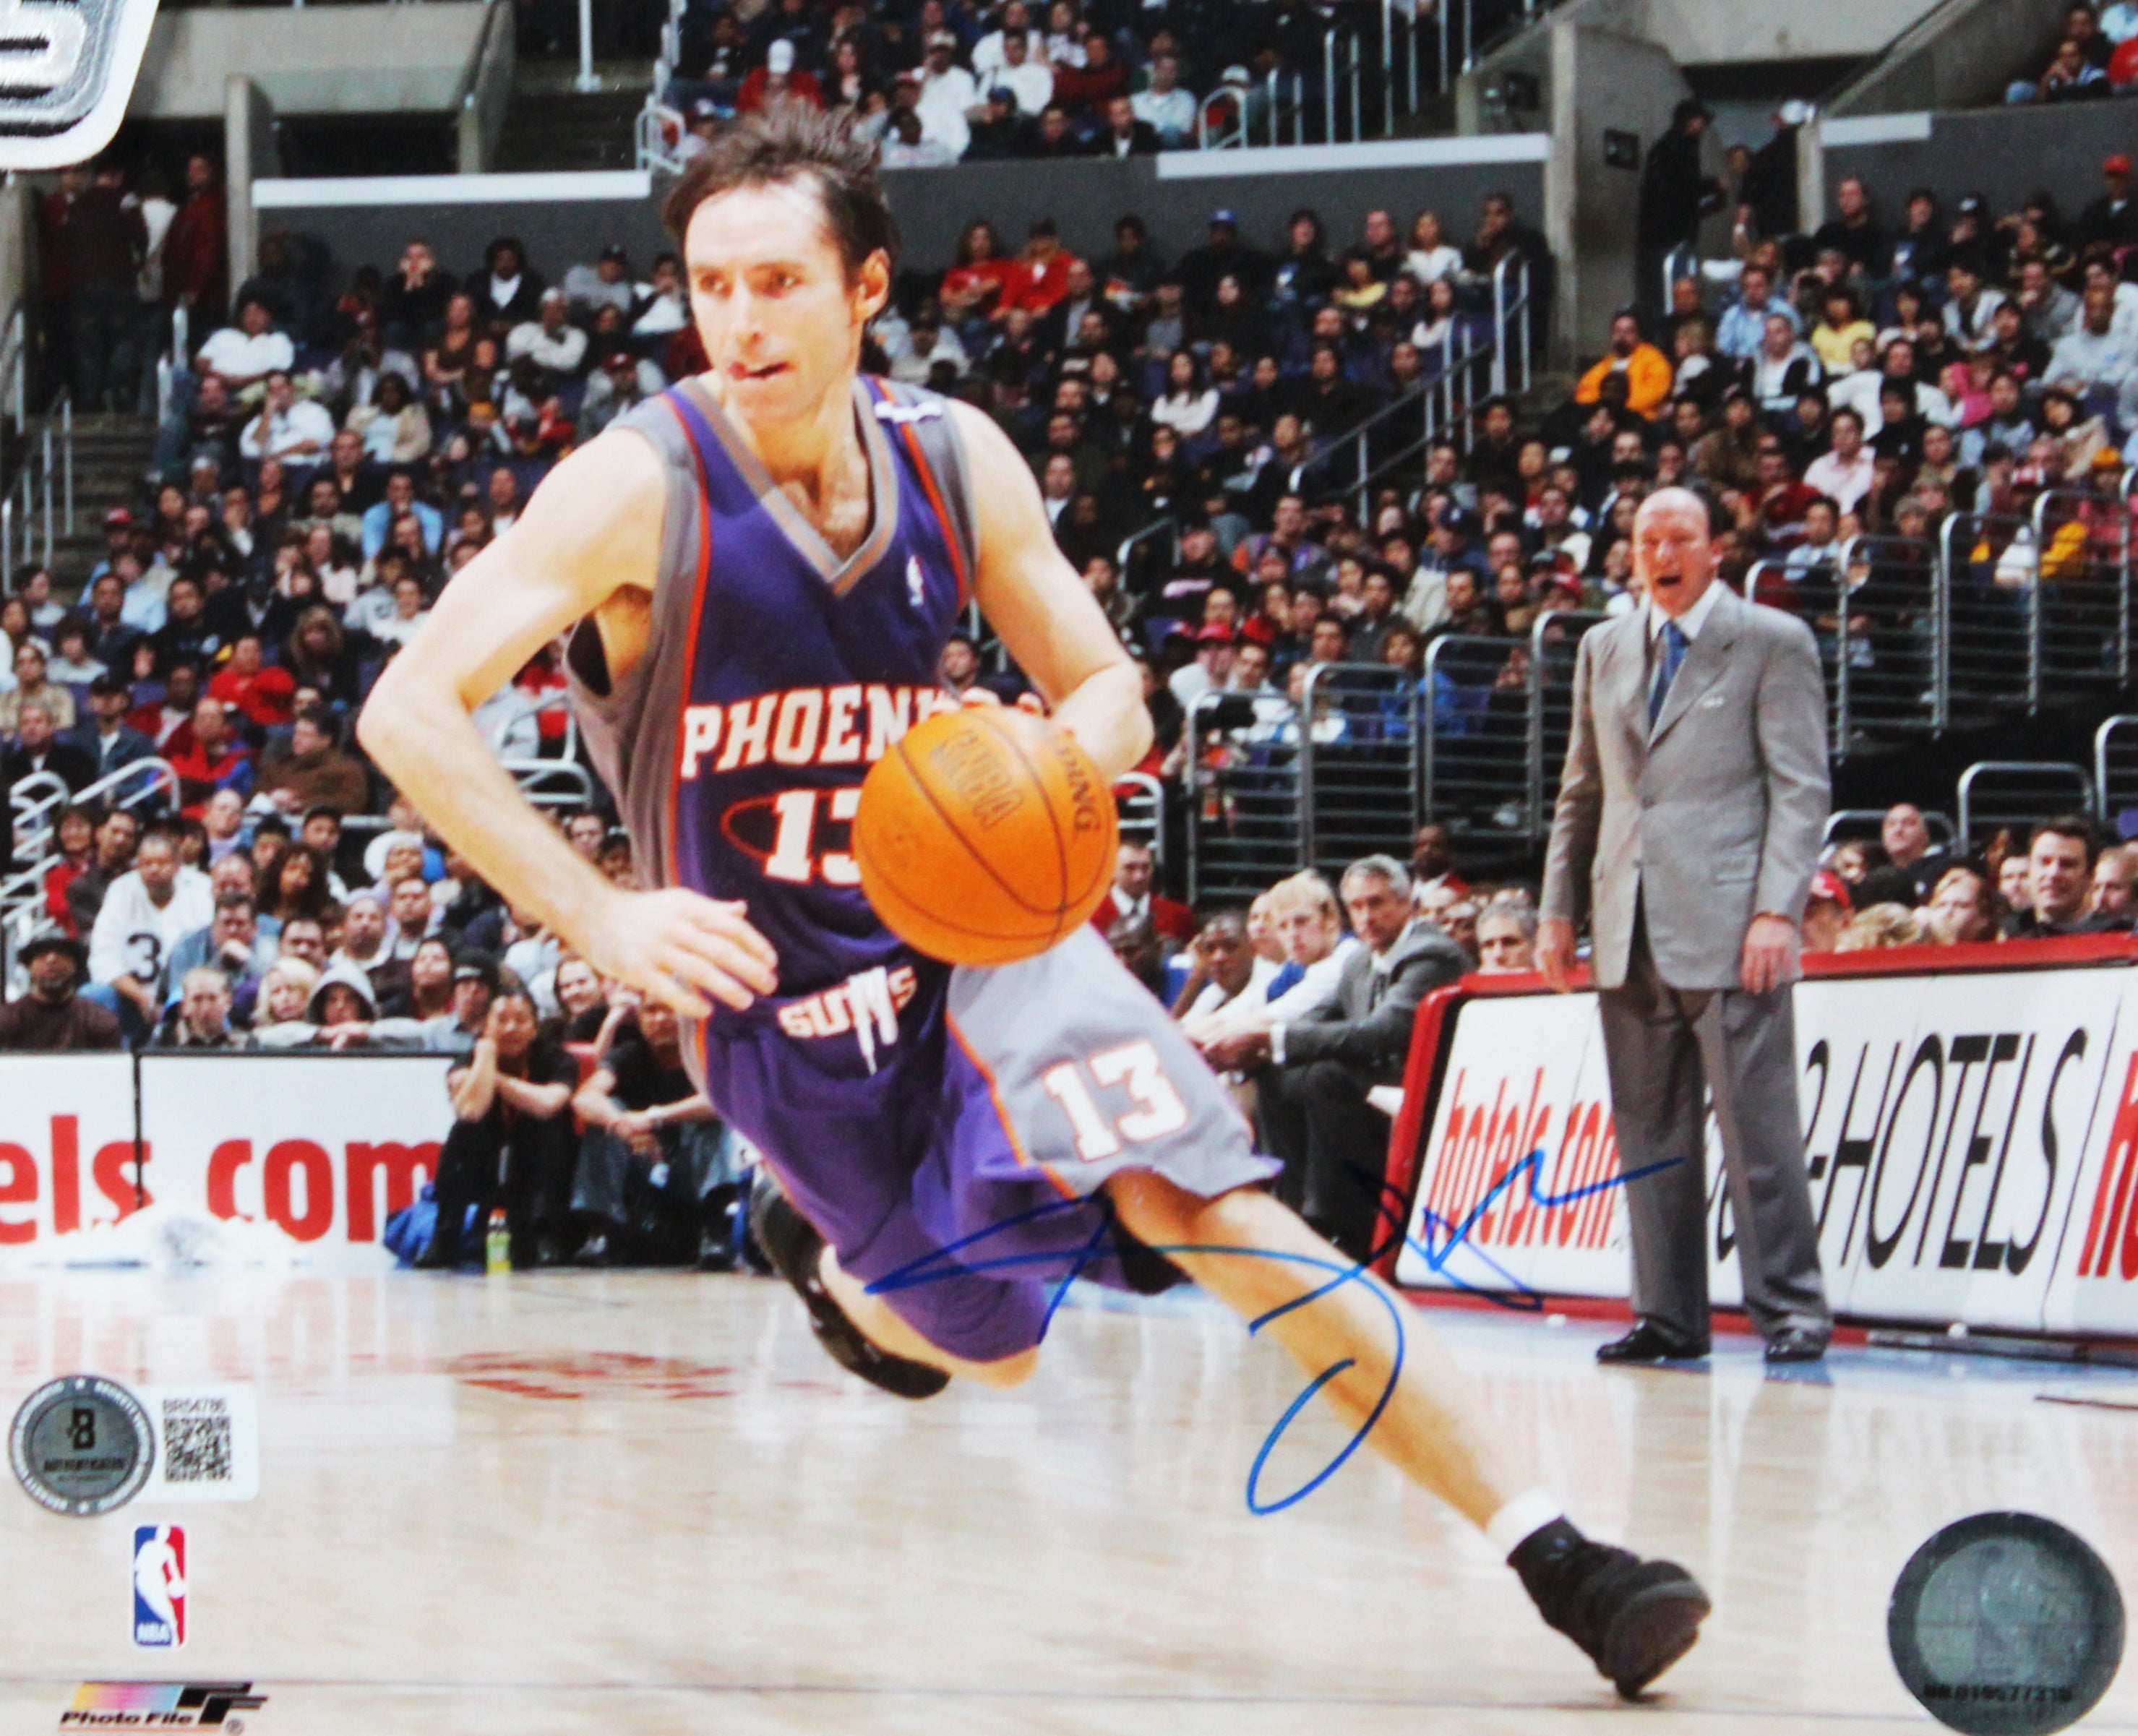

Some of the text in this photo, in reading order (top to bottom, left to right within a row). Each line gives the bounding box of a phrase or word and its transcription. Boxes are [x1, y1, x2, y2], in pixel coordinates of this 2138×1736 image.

[126, 932, 161, 983] 3
[778, 965, 918, 1039] SUS
[1042, 1039, 1187, 1162] 13
